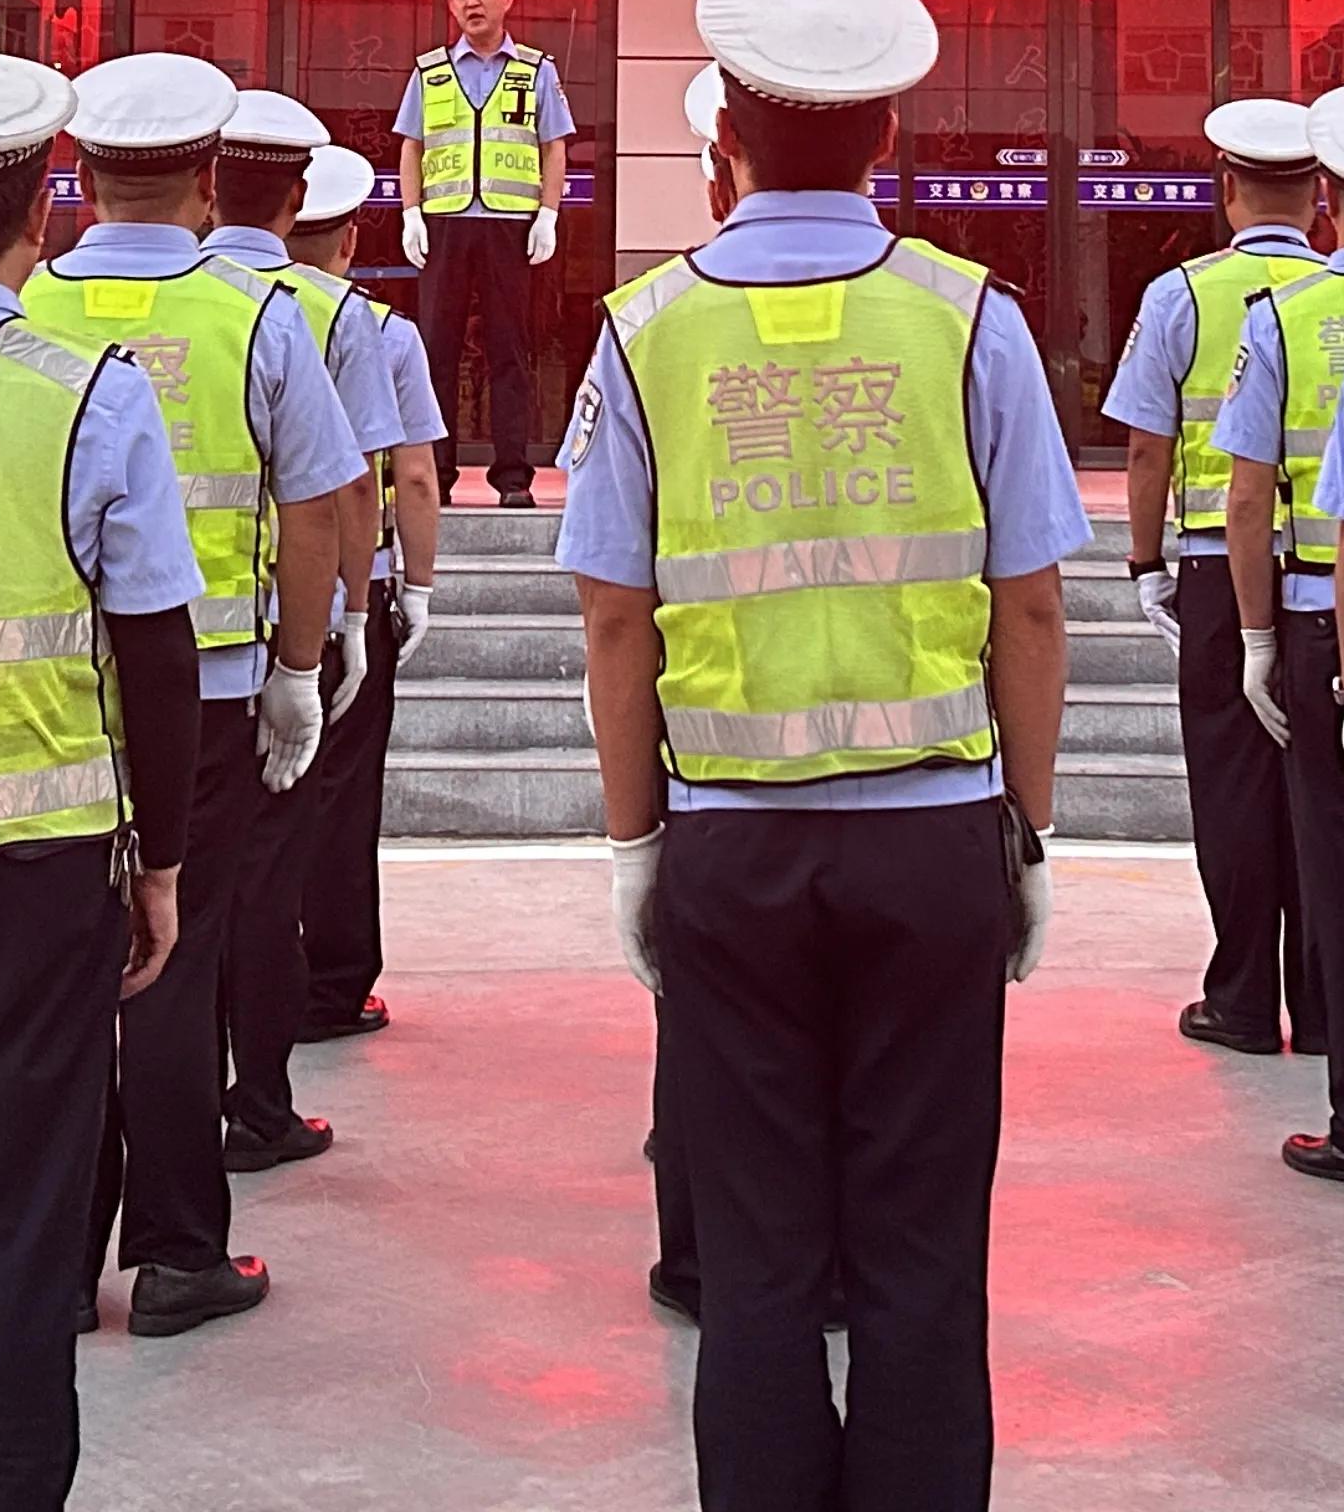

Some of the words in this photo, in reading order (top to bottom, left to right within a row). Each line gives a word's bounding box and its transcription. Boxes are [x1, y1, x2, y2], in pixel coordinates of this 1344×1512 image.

[494, 152, 537, 174] POLICE
[707, 356, 905, 465] 警察
[710, 466, 916, 520] POLICE
